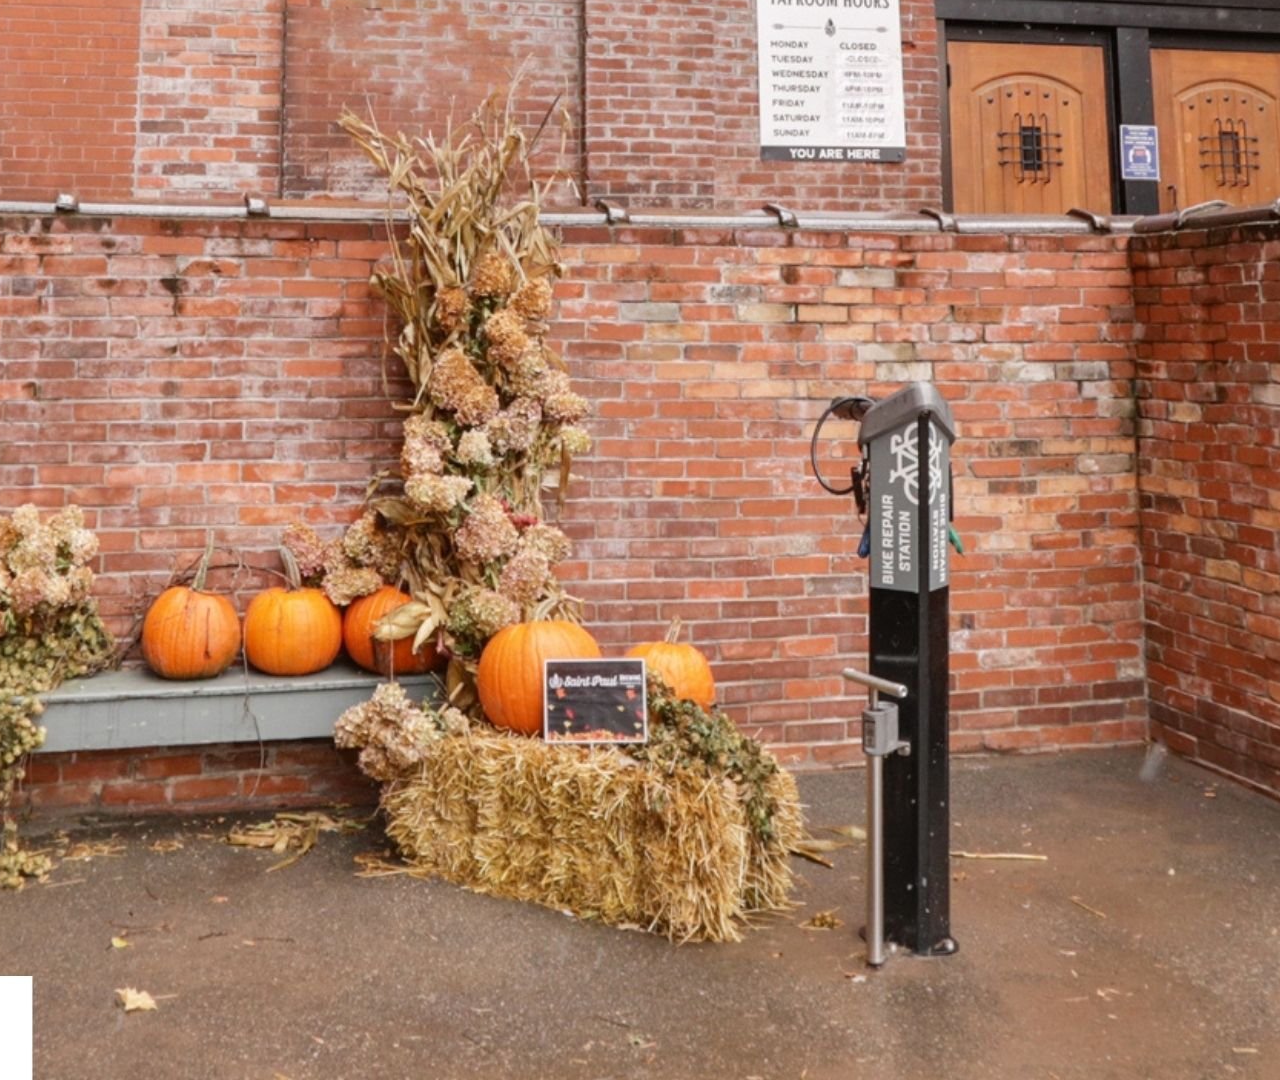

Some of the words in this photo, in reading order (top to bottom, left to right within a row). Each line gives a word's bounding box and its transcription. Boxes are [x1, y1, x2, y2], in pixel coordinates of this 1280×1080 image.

[770, 40, 809, 49] MONDAY
[839, 42, 877, 51] CLOSED
[771, 55, 813, 64] TUESDAY
[772, 70, 829, 79] WEDNESDAY
[772, 84, 821, 93] THURSDAY
[772, 99, 805, 108] FRIDAY
[773, 113, 821, 123] SATURDAY
[773, 128, 810, 137] SUNDAY
[789, 148, 816, 159] YOU
[819, 148, 843, 159] ARE
[847, 149, 881, 160] HERE
[882, 494, 894, 548] REPAIR
[898, 511, 911, 572] STATION
[882, 549, 894, 585] BIKE
[564, 675, 591, 687] Saint
[591, 674, 617, 687] Paul
